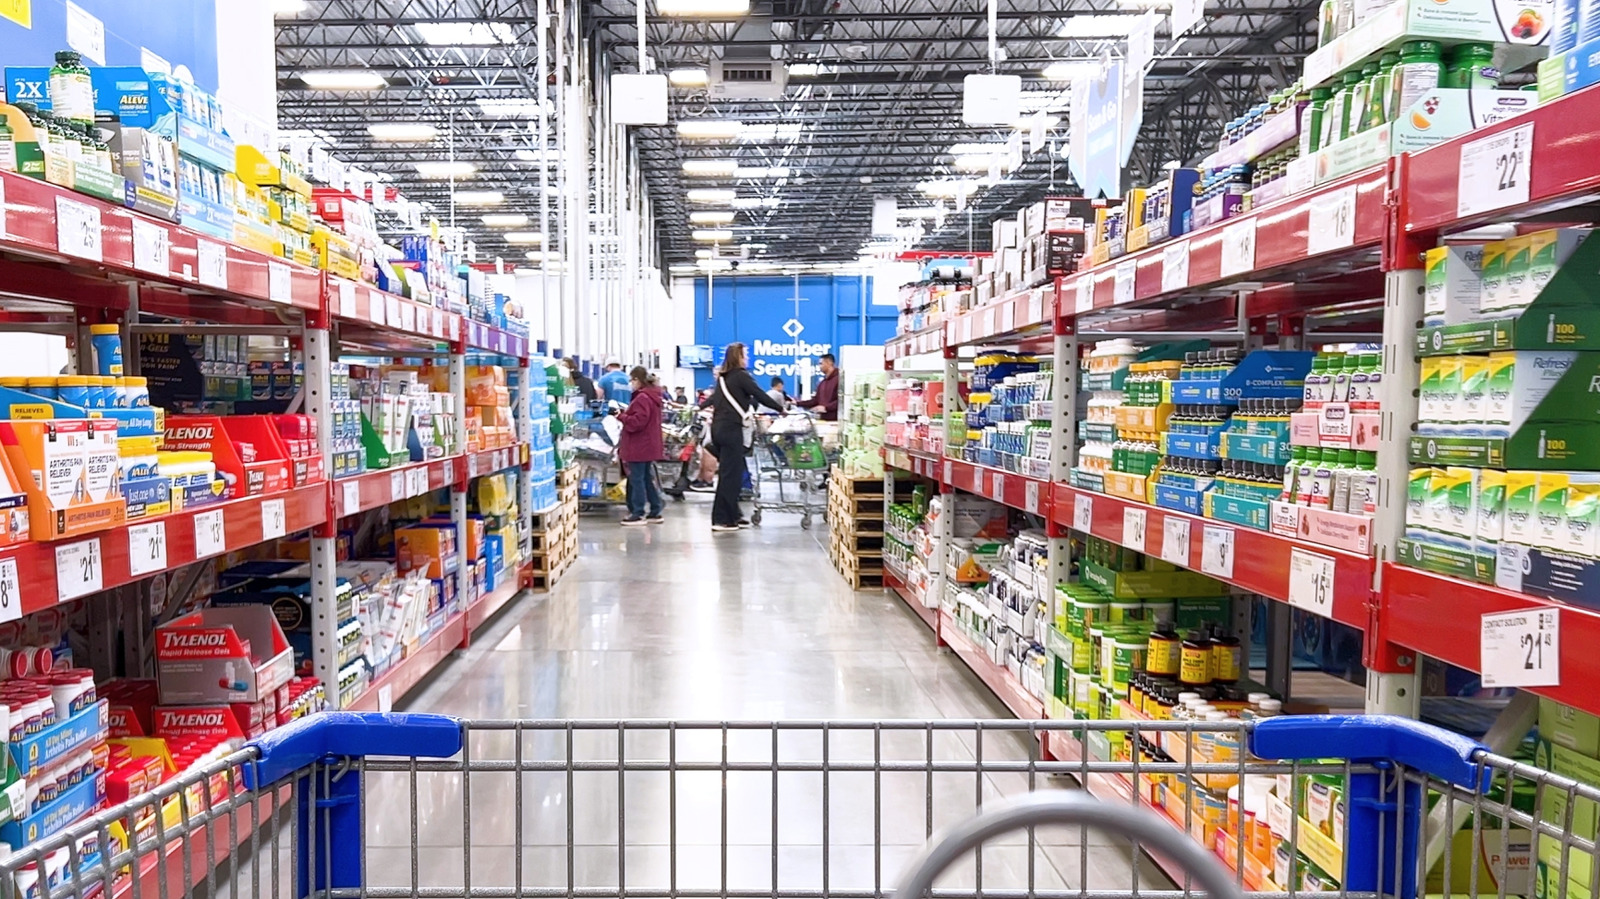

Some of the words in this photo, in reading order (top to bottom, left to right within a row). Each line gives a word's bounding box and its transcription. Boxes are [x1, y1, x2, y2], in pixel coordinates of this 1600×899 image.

[14, 81, 43, 98] 2X
[119, 94, 149, 105] ALEVE
[1229, 203, 1243, 213] 40
[1555, 324, 1576, 334] 100
[753, 339, 832, 356] Member
[1223, 387, 1243, 397] 300
[163, 427, 214, 440] YLENOL
[1279, 441, 1292, 451] 30
[1547, 440, 1566, 450] 100
[1, 580, 9, 608] 8
[162, 632, 226, 648] TYLENOL
[160, 649, 182, 657] Rapid
[183, 648, 212, 656] Release
[1520, 632, 1542, 669] $21
[161, 712, 226, 728] TYLENOL
[1491, 854, 1530, 866] Pwer
